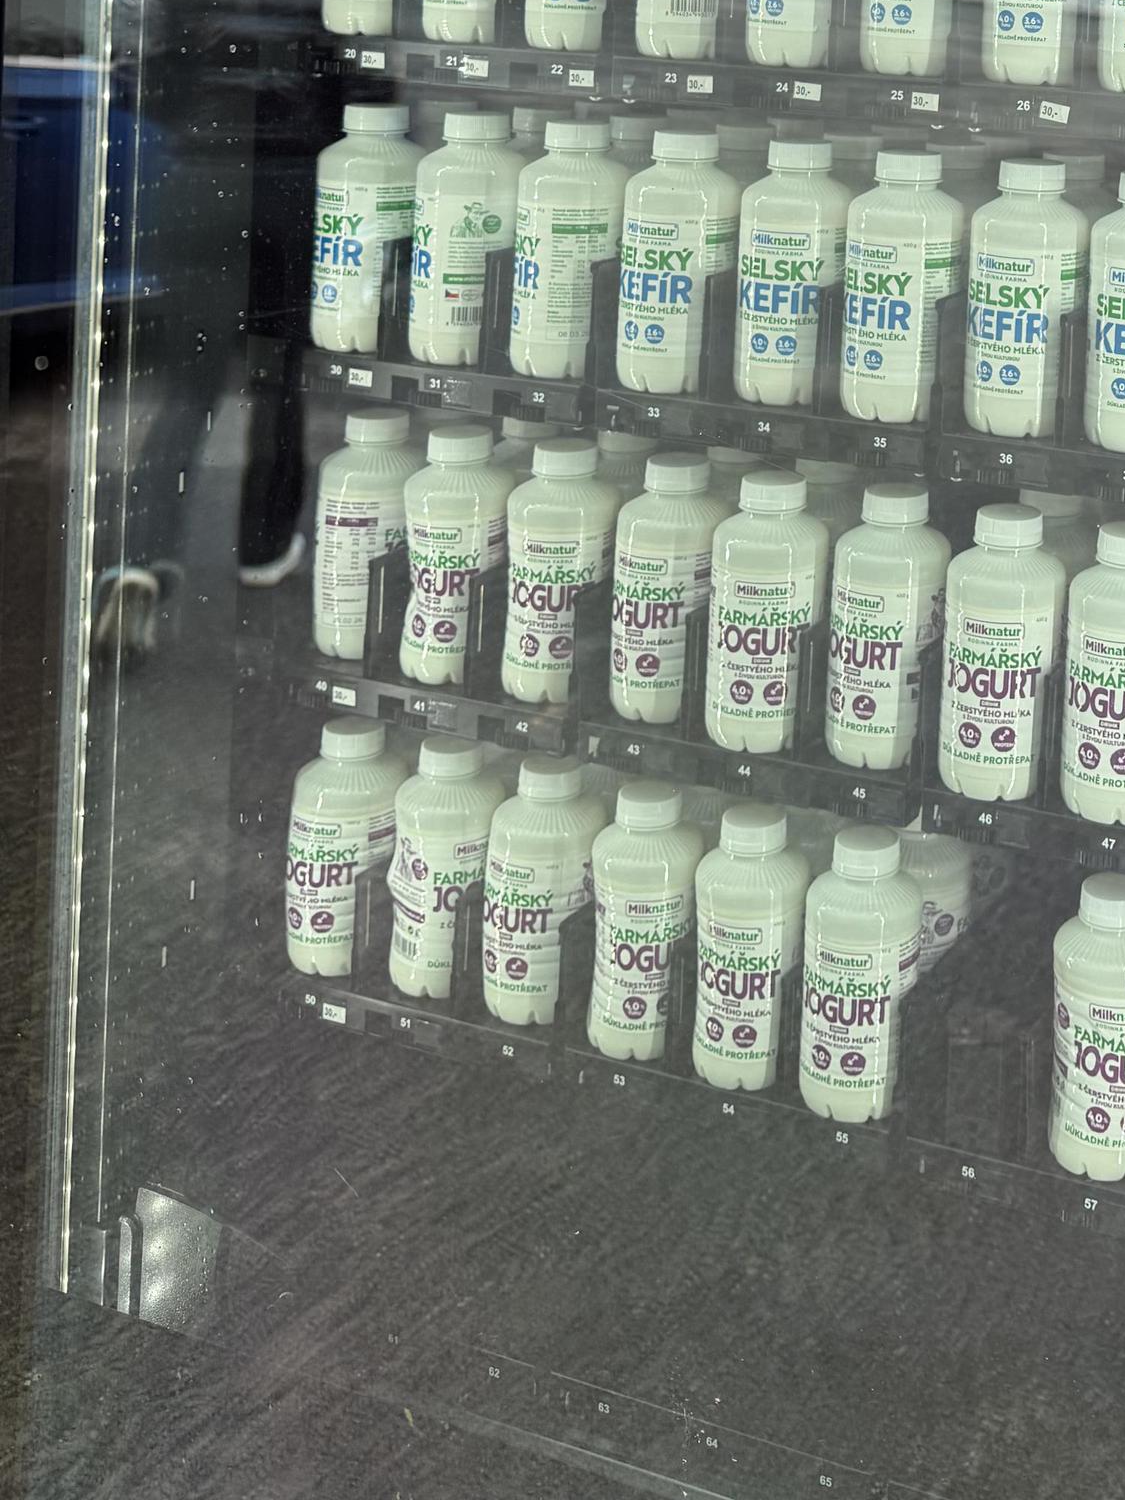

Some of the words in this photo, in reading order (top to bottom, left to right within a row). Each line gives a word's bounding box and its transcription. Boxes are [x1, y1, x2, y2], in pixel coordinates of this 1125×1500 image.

[345, 49, 356, 58] 20
[363, 54, 377, 65] 30,-
[446, 56, 456, 66] 21
[551, 64, 563, 74] 22
[571, 74, 585, 85] 30,-
[665, 73, 676, 83] 23
[689, 78, 703, 90] 30,-
[776, 83, 788, 92] 24
[796, 85, 811, 96] 30,-
[891, 91, 903, 100] 25
[913, 96, 928, 107] 30,-
[1017, 101, 1030, 111] 26
[1042, 105, 1058, 117] 30,-
[969, 278, 1050, 309] SELSKÝ
[967, 302, 1049, 343] KEFÍR
[331, 365, 342, 375] 30
[430, 379, 440, 388] 31
[533, 392, 544, 402] 32
[648, 407, 659, 417] 33
[758, 422, 770, 432] 34
[874, 437, 886, 447] 35
[1000, 454, 1012, 464] 36
[966, 621, 1022, 637] Milknatur
[949, 641, 1042, 669] FARMÁŘSKÝ
[948, 657, 1041, 699] JOGURT
[316, 681, 327, 691] 40
[414, 701, 424, 711] 41
[516, 722, 528, 732] 42
[628, 744, 639, 755] 43
[738, 765, 750, 776] 44
[853, 788, 865, 798] 45
[979, 813, 992, 824] 46
[1102, 838, 1115, 849] 47
[305, 994, 316, 1005] 50
[401, 1018, 410, 1028] 51
[503, 1045, 513, 1056] 52
[614, 1075, 625, 1085] 53
[723, 1103, 734, 1115] 54
[836, 1132, 848, 1143] 55
[962, 1166, 974, 1178] 56
[1085, 1198, 1097, 1210] 57
